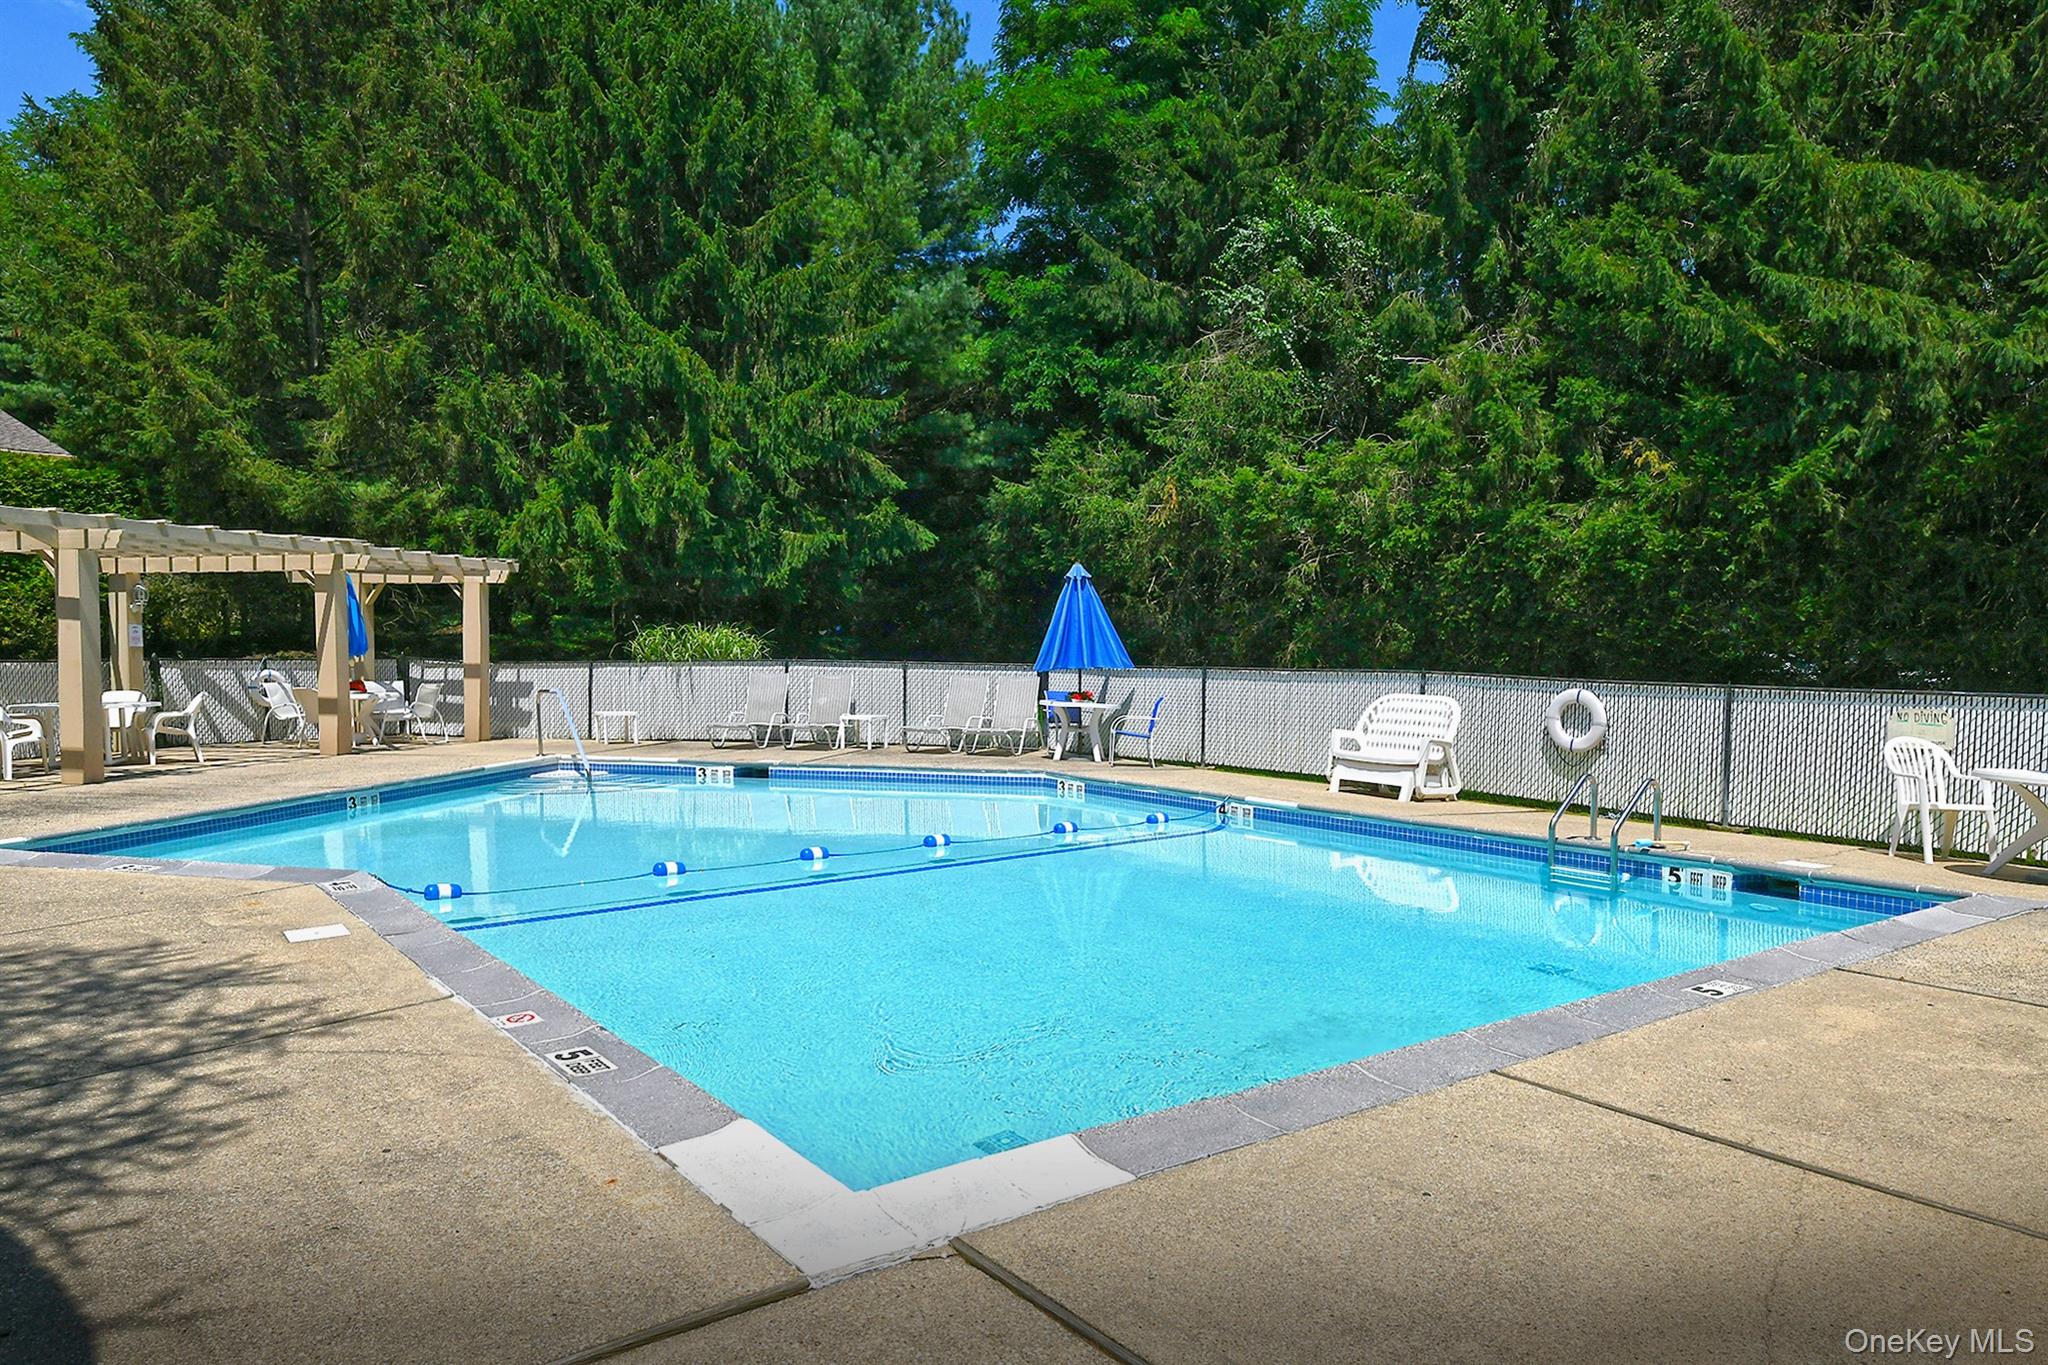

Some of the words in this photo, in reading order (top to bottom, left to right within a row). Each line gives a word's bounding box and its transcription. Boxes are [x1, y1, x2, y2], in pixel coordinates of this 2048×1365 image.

[1897, 712, 1909, 722] NO
[348, 796, 357, 809] 3
[1690, 986, 1724, 996] 5
[554, 1049, 593, 1061] 5
